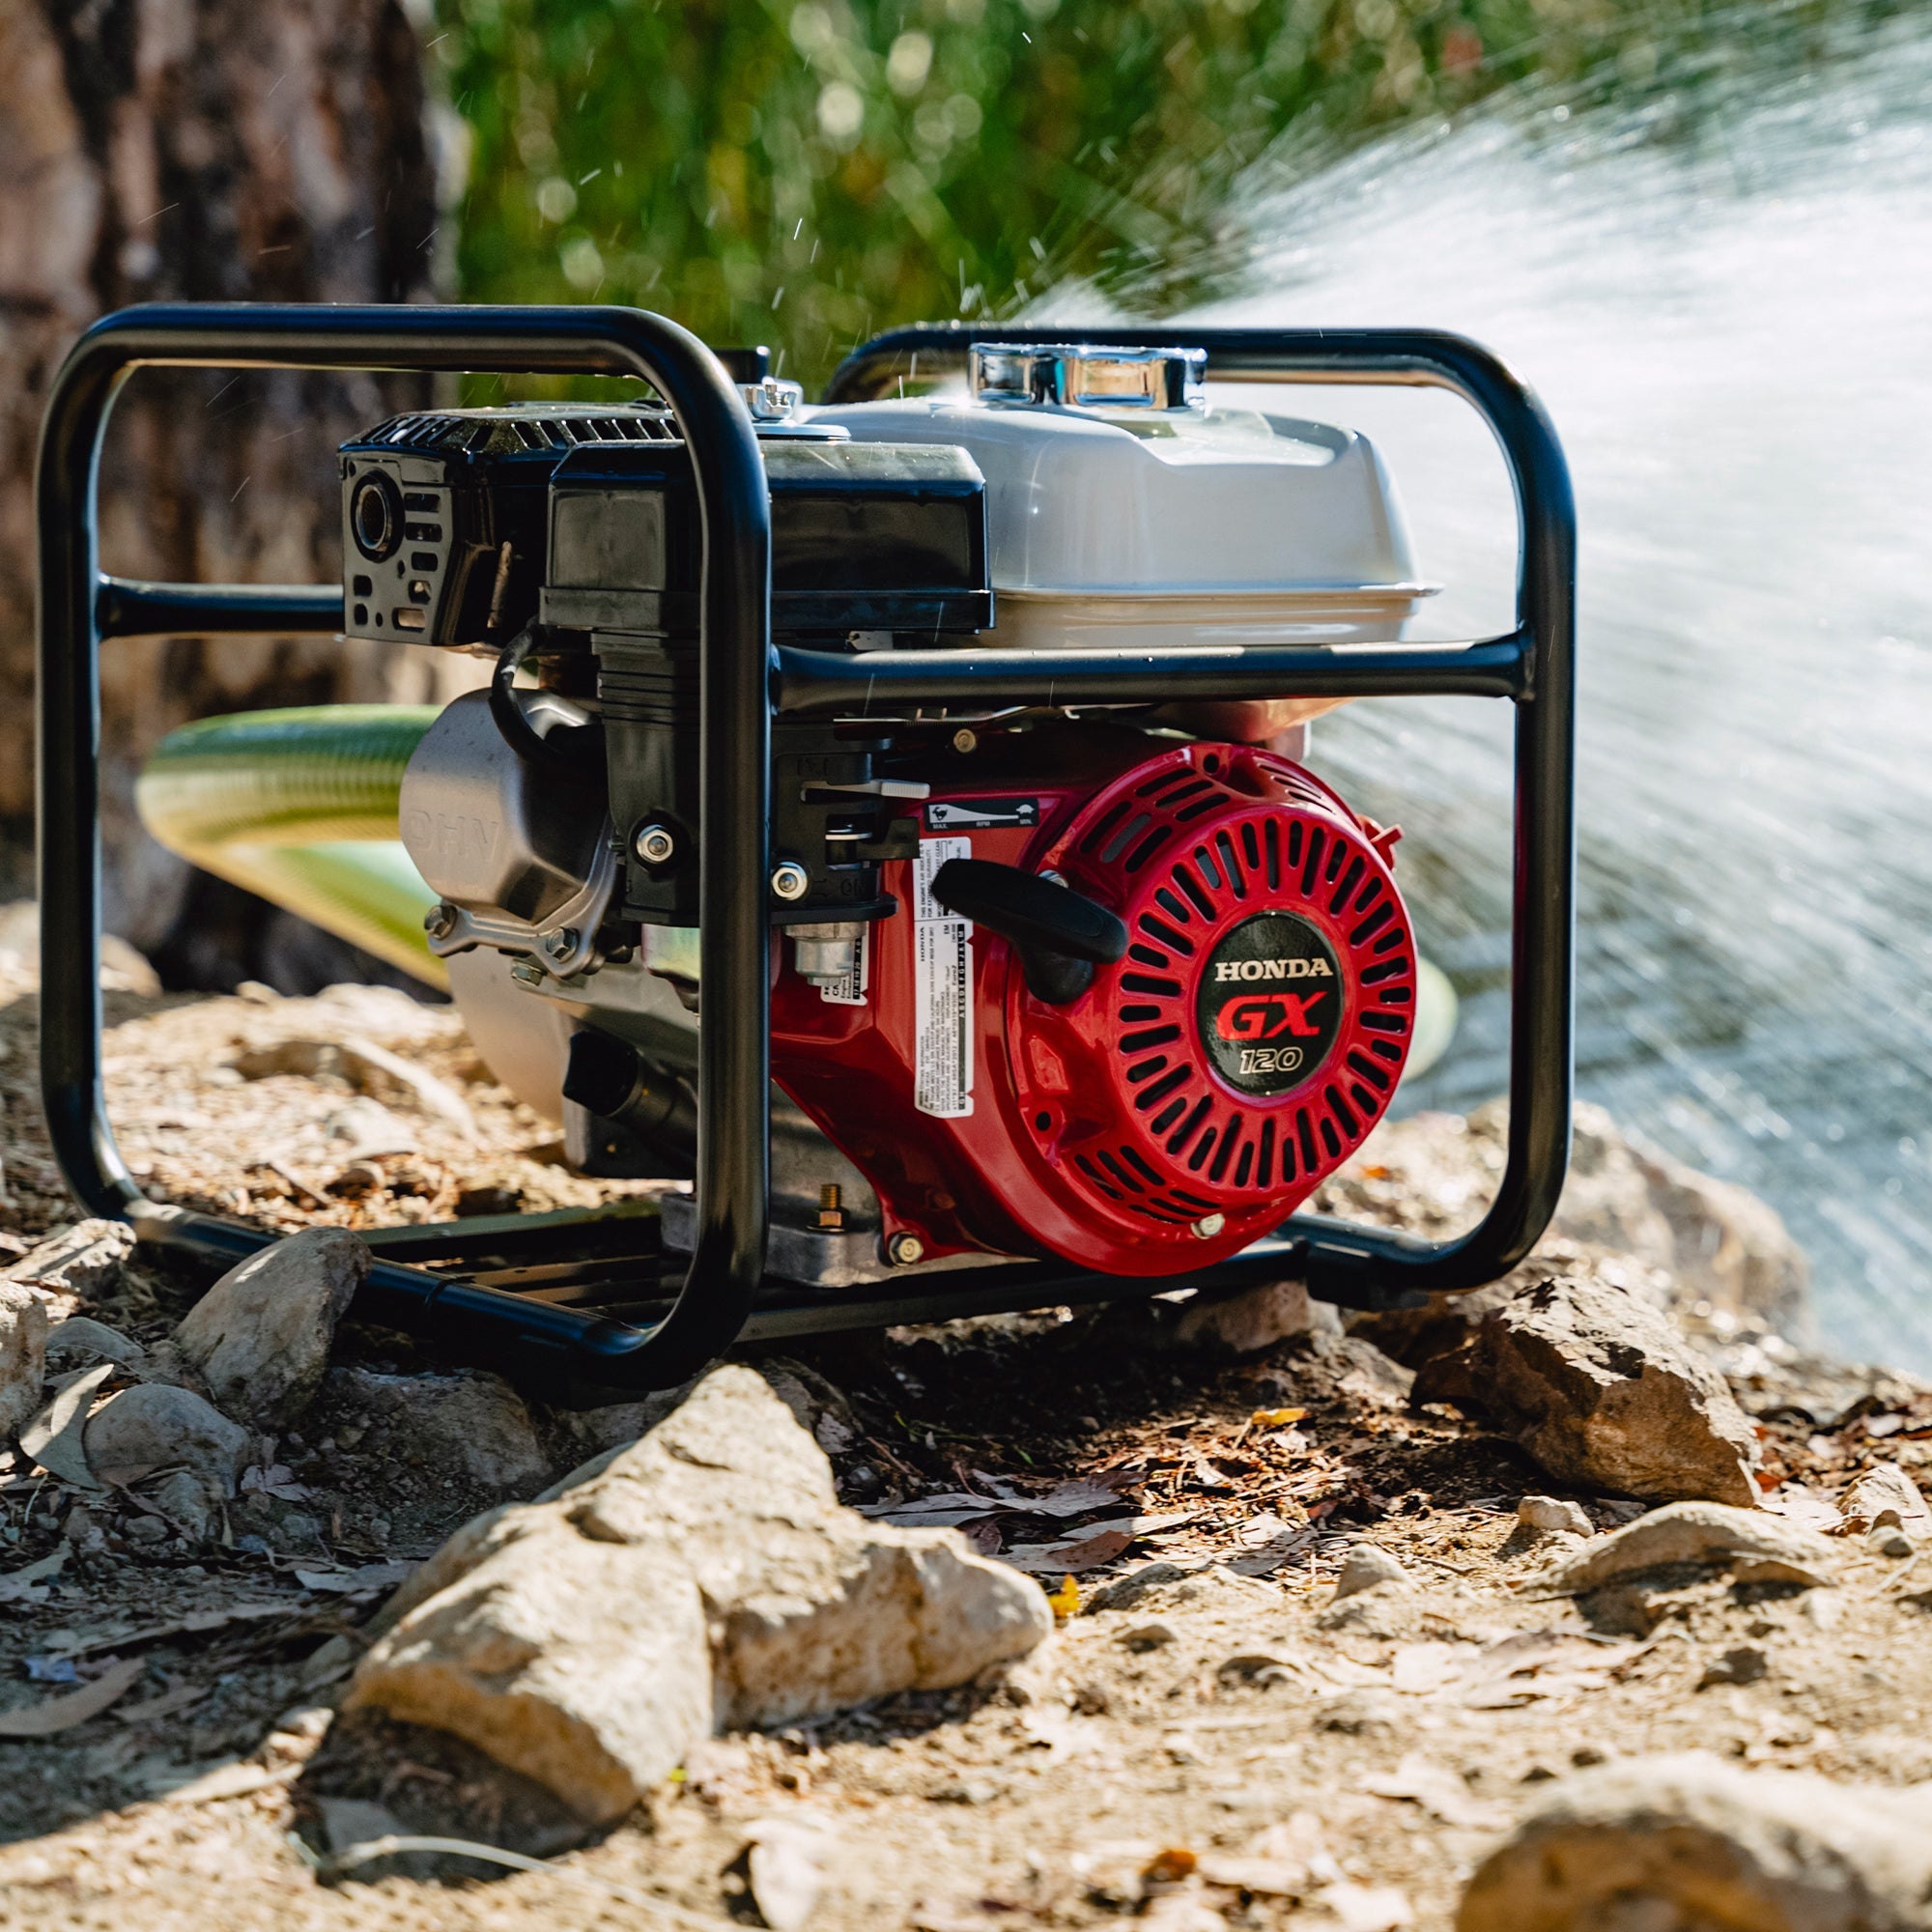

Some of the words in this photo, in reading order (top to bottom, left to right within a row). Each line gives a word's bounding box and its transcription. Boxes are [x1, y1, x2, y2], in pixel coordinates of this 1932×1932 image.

[944, 923, 950, 935] EM
[1214, 958, 1333, 981] HONDA
[1216, 991, 1327, 1040] GX
[1239, 1046, 1303, 1074] 120
